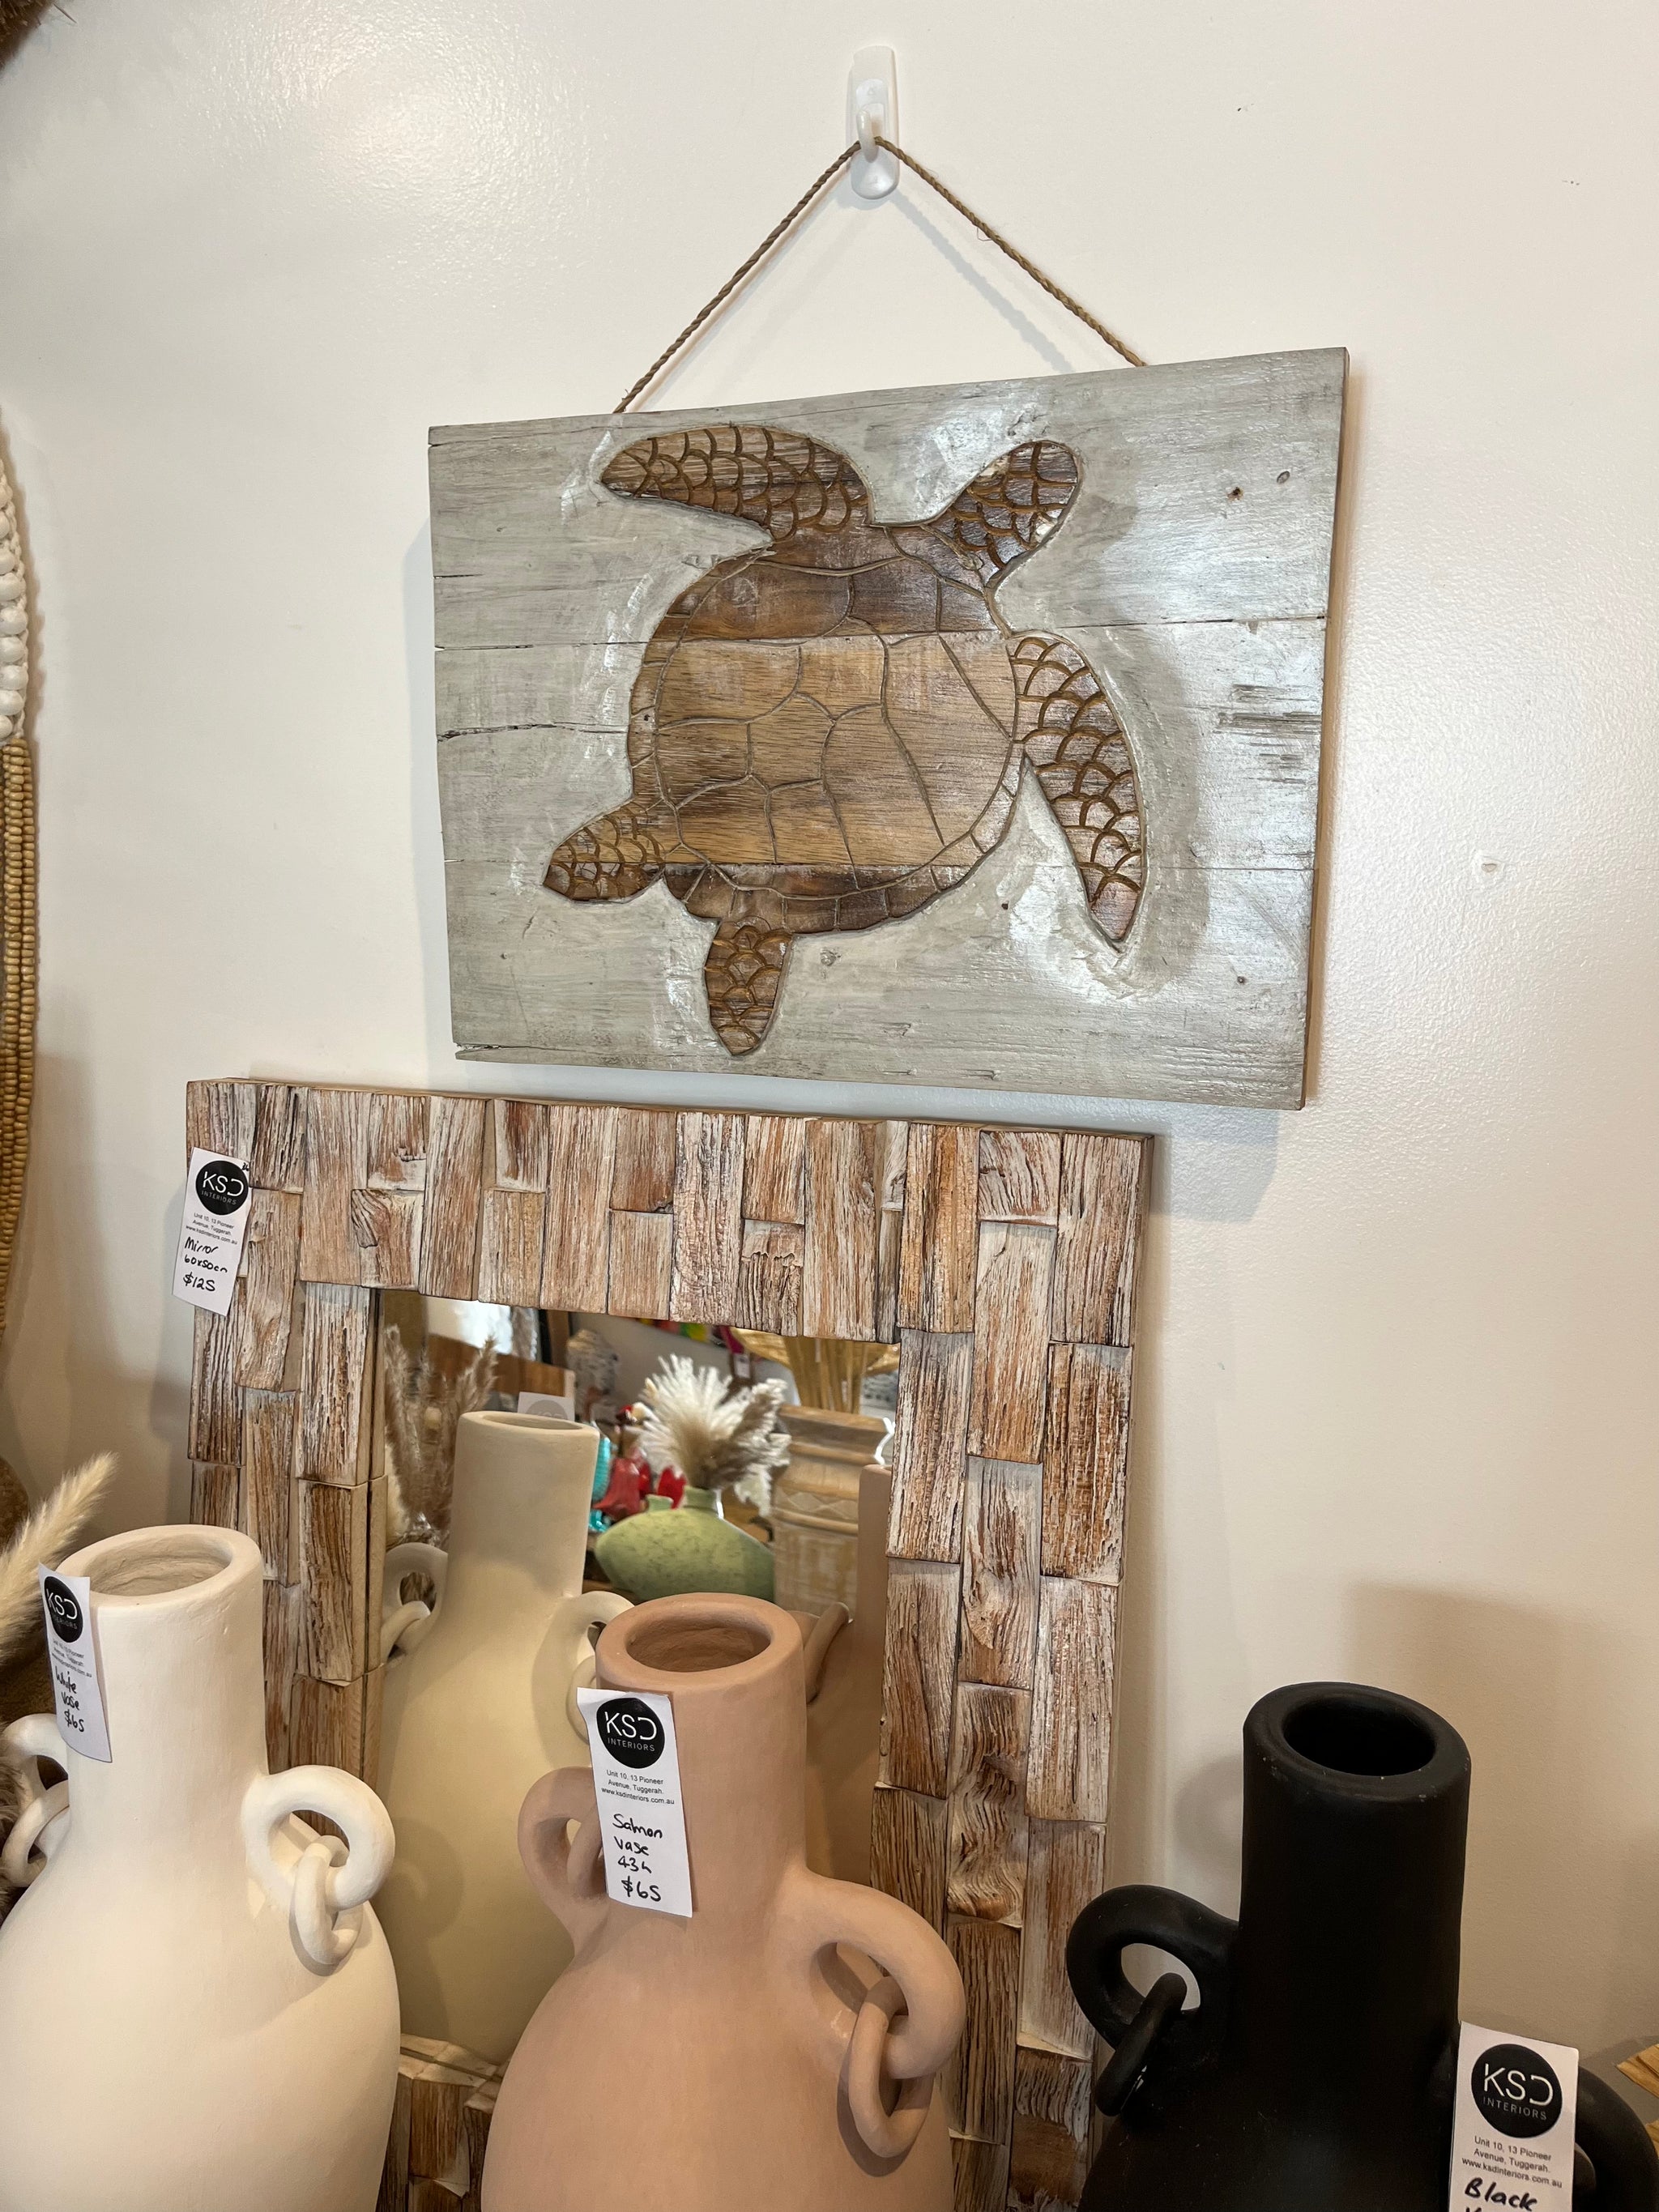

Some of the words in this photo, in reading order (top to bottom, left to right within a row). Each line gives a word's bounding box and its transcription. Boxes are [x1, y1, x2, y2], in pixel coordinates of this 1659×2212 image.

[203, 1171, 244, 1197] KSD
[201, 1190, 237, 1205] INTERIORS
[183, 1271, 215, 1292] $125
[46, 1588, 77, 1619] KSD
[64, 1709, 84, 1733] $65
[604, 1711, 657, 1741] KSD
[607, 1737, 655, 1752] INTERIORS
[607, 1769, 618, 1778] Unit
[639, 1776, 663, 1785] Pioneer
[601, 1787, 675, 1805] www.ksdinteriors.com.au
[612, 1813, 663, 1839] Salmon
[621, 1875, 662, 1902] $65
[1483, 2063, 1554, 2106] KSD
[1483, 2096, 1547, 2121] INTERIORS
[1473, 2148, 1507, 2165] Avenue,
[1474, 2135, 1491, 2147] Unit
[1508, 2146, 1518, 2154] 13
[1520, 2147, 1552, 2162] Pioneer
[1461, 2158, 1563, 2189] www.ksdinteriors.com.au
[1465, 2176, 1537, 2212] Black
